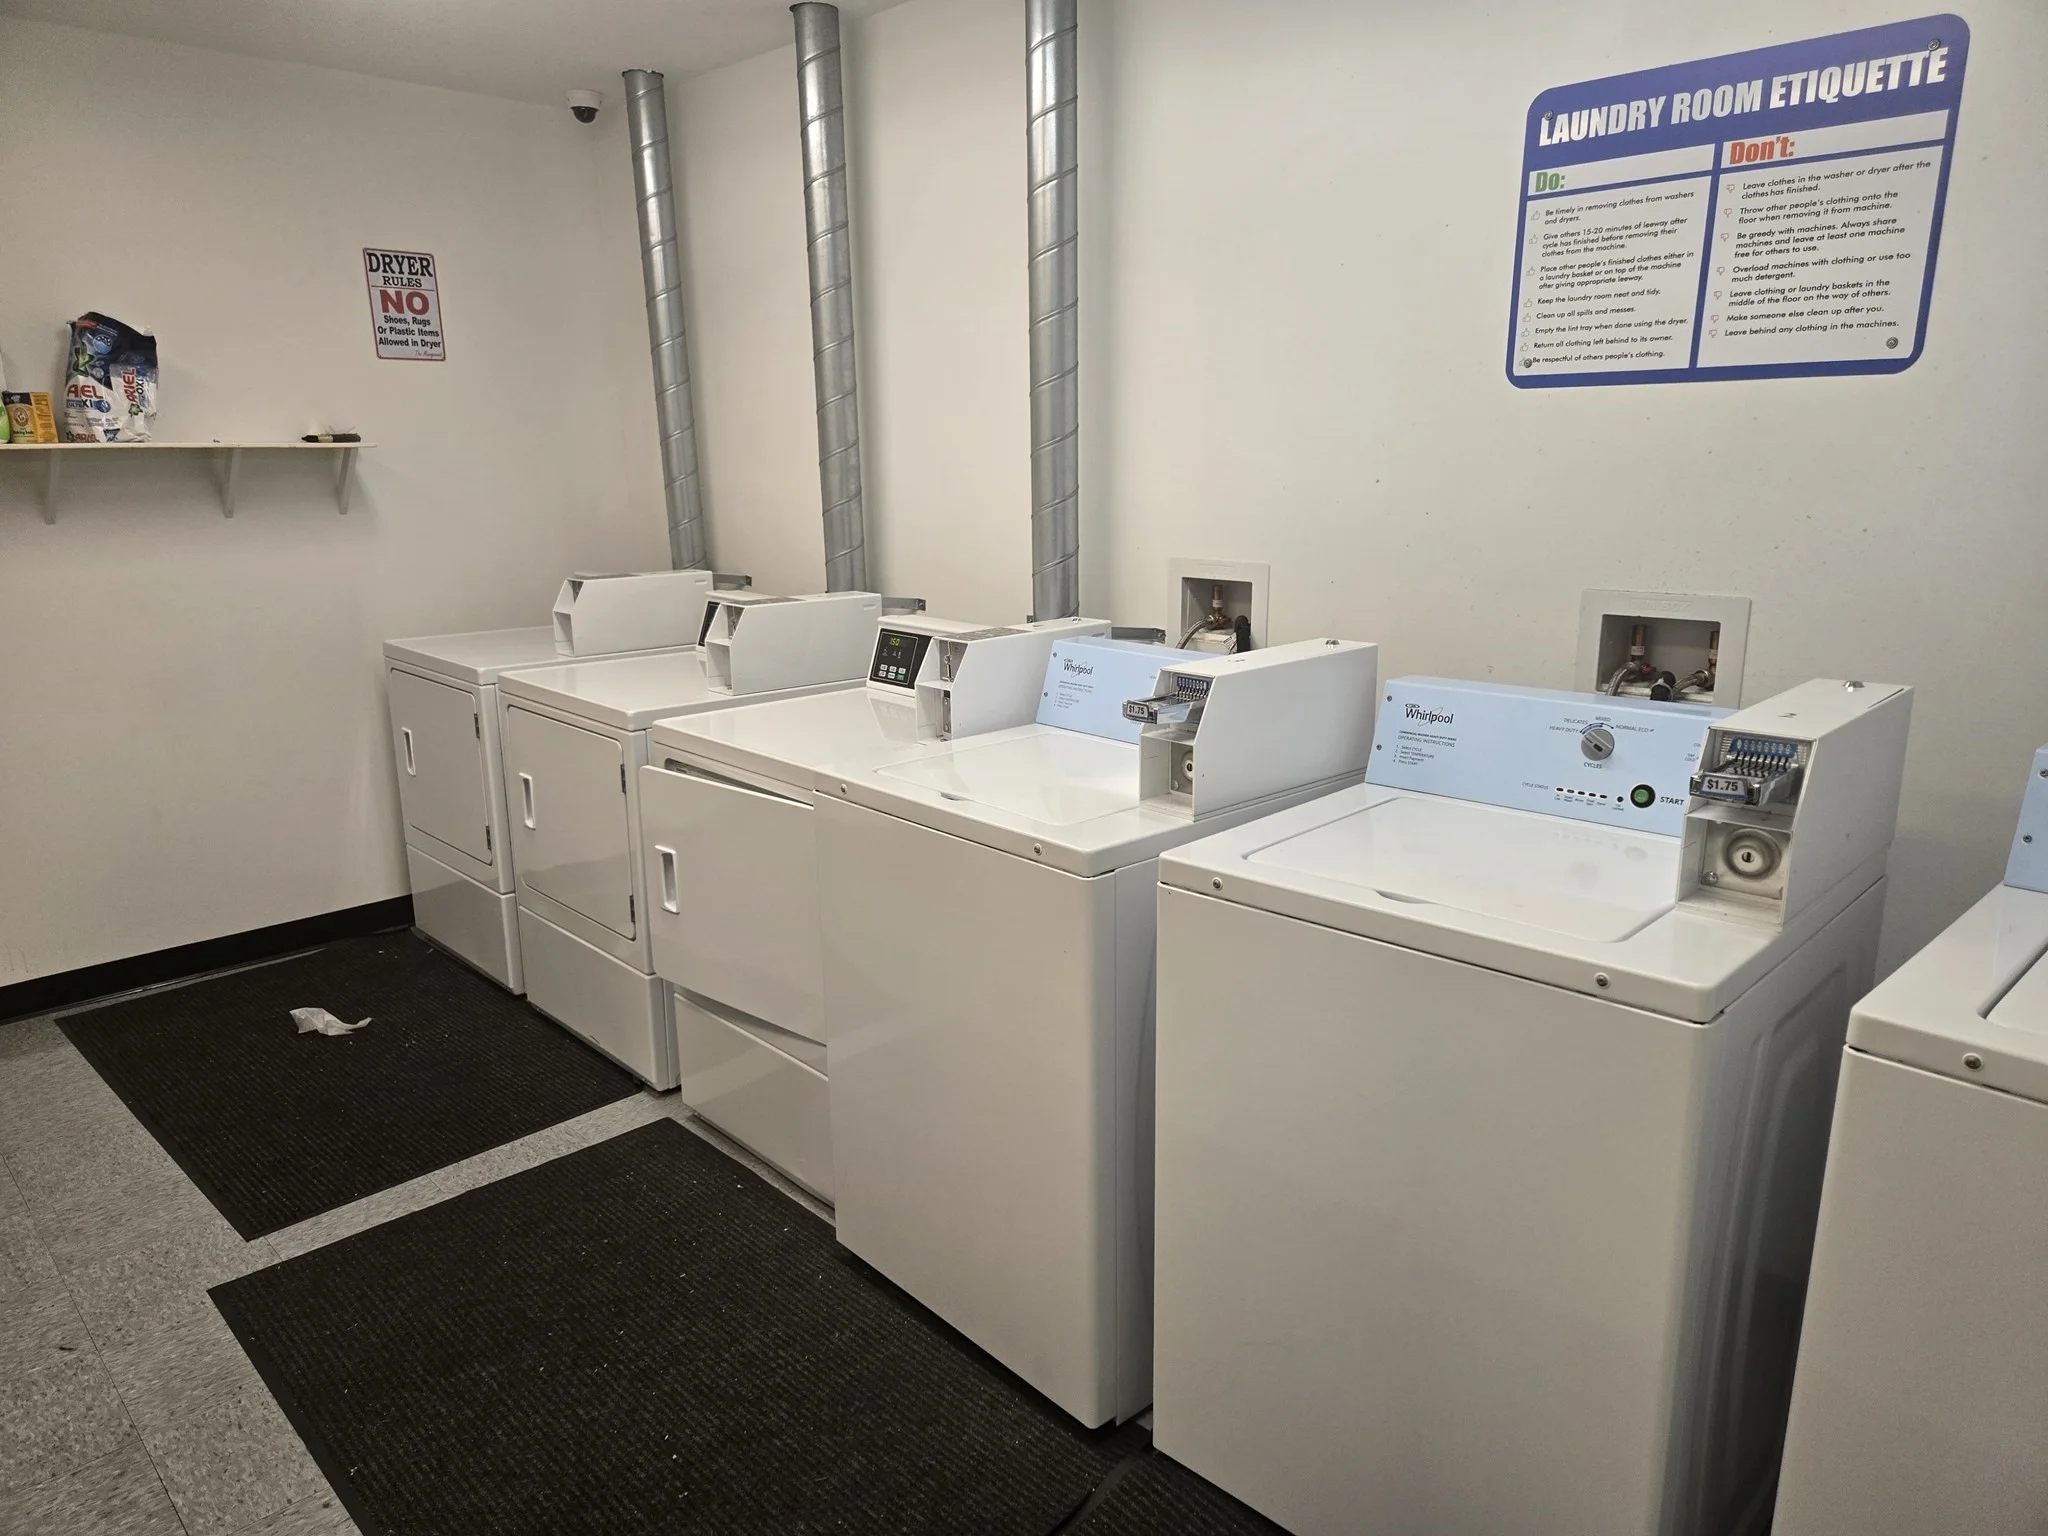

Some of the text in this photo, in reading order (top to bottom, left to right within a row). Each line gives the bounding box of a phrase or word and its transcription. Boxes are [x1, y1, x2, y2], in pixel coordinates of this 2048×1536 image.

[1539, 47, 1949, 147] LAUNDRY ROOM ETIQUETTE
[1729, 135, 1795, 165] Don't:
[1768, 178, 1795, 186] clothes
[1808, 174, 1821, 182] the
[1823, 171, 1854, 180] washer
[1893, 164, 1914, 172] after
[1916, 161, 1931, 169] the
[1535, 172, 1566, 192] Do:
[1742, 190, 1769, 199] clothes
[1786, 184, 1820, 194] finished.
[1555, 206, 1575, 215] timely
[1585, 202, 1617, 211] removing
[1619, 198, 1643, 206] clothes
[1664, 191, 1694, 200] washers
[1766, 204, 1787, 212] other
[1789, 199, 1824, 211] people's
[1826, 196, 1860, 205] clothing
[1862, 193, 1882, 201] onto
[1884, 191, 1898, 199] the
[1544, 215, 1581, 224] and dryers.
[1738, 216, 1756, 224] floor
[1783, 210, 1821, 219] removing
[1853, 203, 1892, 212] machine.
[1749, 229, 1776, 240] greedy
[1778, 227, 1795, 235] with
[1797, 224, 1838, 233] machines.
[1872, 218, 1897, 226] share
[1735, 239, 1772, 248] machines
[1774, 236, 1790, 244] and
[1827, 231, 1847, 239] least
[1868, 227, 1905, 235] machine
[1765, 247, 1790, 255] others
[366, 252, 433, 277] DRYER
[1733, 263, 1769, 273] Overload
[1771, 261, 1809, 270] machines
[1831, 257, 1864, 265] clothing
[382, 276, 422, 288] RULES
[1731, 270, 1795, 282] much detergent.
[1754, 287, 1785, 295] clothing
[1798, 284, 1830, 292] laundry
[1832, 281, 1863, 290] baskets
[379, 289, 430, 315] NO
[1538, 297, 1554, 305] Keep
[1567, 294, 1592, 302] laundry
[1614, 290, 1629, 298] neat
[1647, 288, 1661, 296] tidy.
[1728, 298, 1755, 306] middle
[1767, 296, 1780, 304] the
[1851, 290, 1860, 298] of
[1862, 289, 1890, 297] others.
[1577, 308, 1593, 317] spills
[1844, 306, 1864, 314] after
[384, 315, 431, 327] Shoes, Rugs
[1749, 326, 1776, 334] behind
[1795, 324, 1827, 332] clothing
[1856, 320, 1899, 328] machines.
[378, 326, 439, 337] Or Plastic Items
[379, 338, 441, 349] Allowed in Dryer
[1542, 354, 1573, 363] respectful
[1605, 351, 1633, 361] people's
[1635, 350, 1665, 359] clothing.
[122, 368, 136, 401] ARIEL
[1064, 662, 1093, 675] Whirlpool
[1128, 705, 1145, 715] $1.75
[1405, 708, 1454, 724] Whirlpool
[1398, 735, 1422, 743] OPERATING
[1423, 739, 1455, 747] INSTRUCTIONS
[1707, 779, 1738, 791] $1.75
[1660, 796, 1684, 806] START
